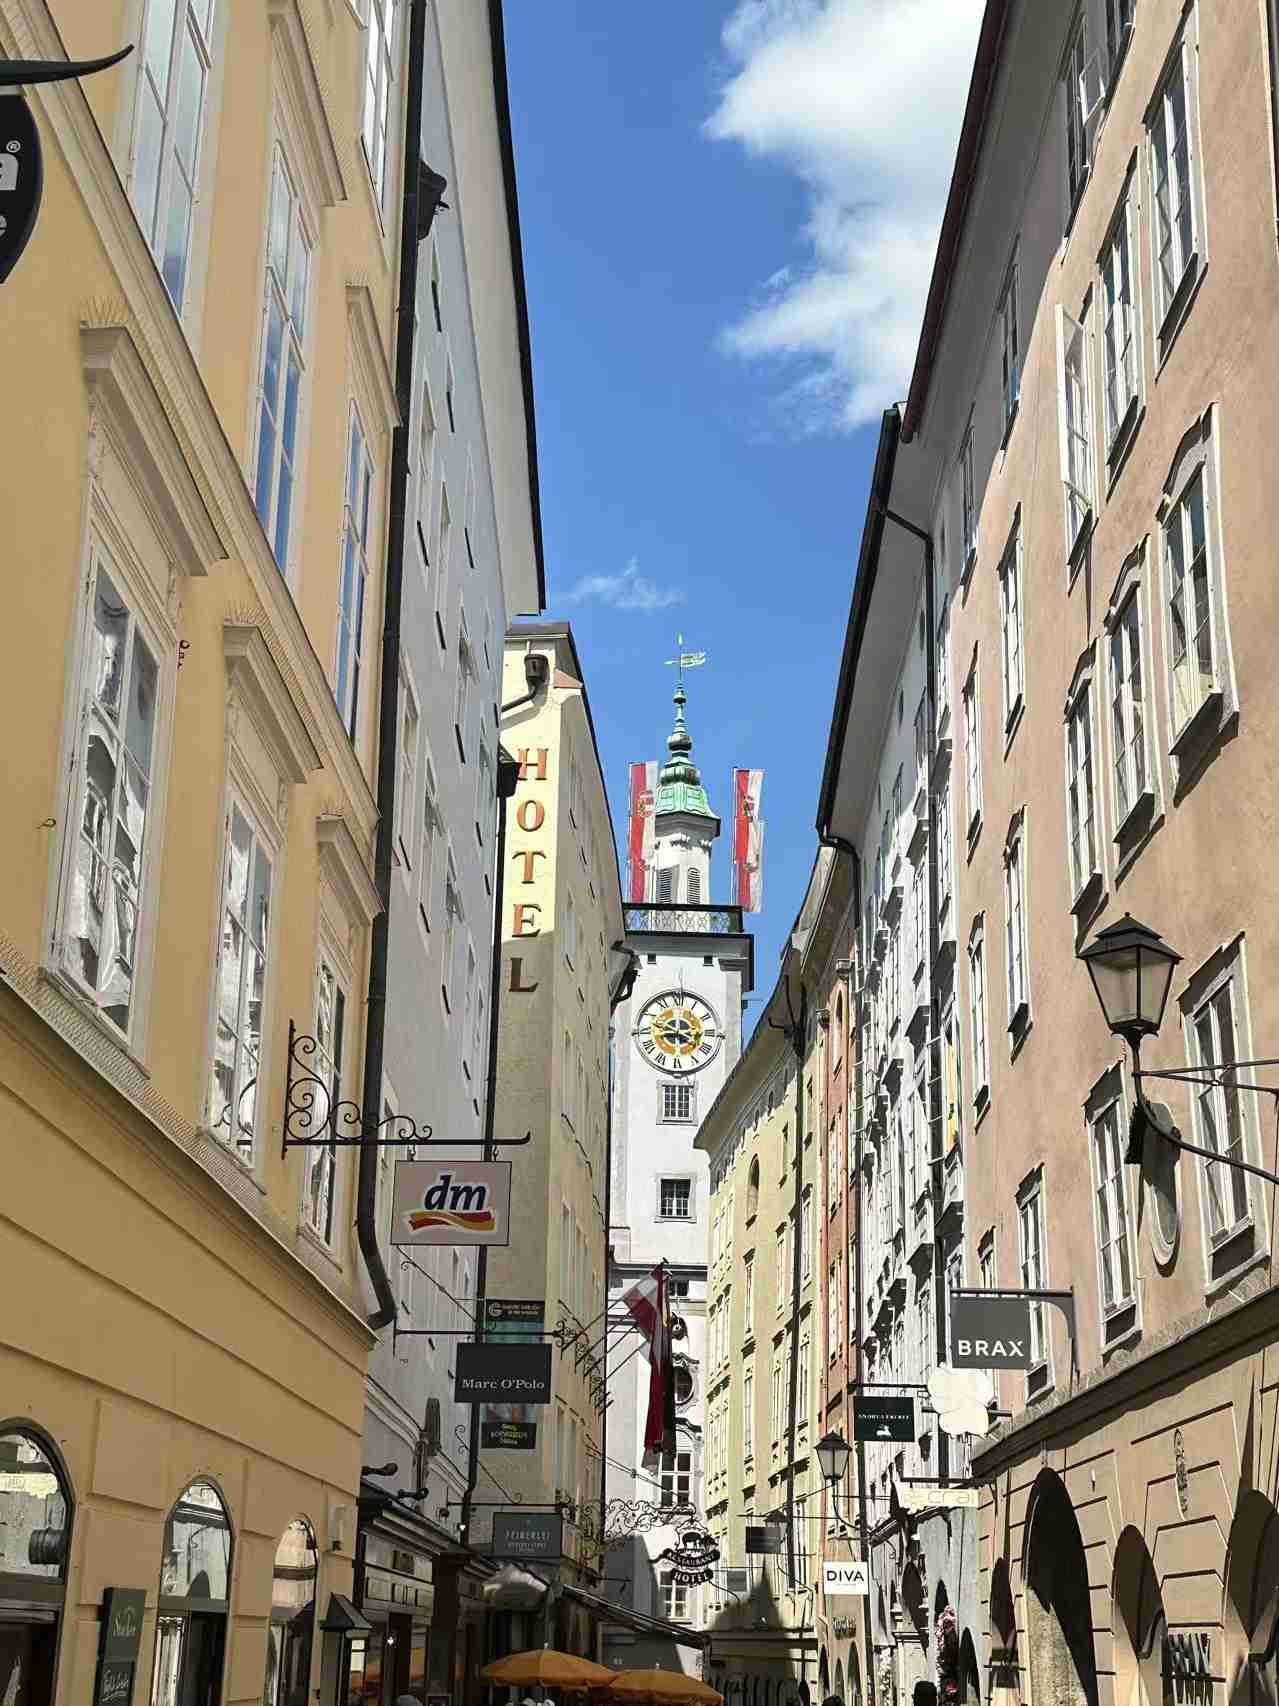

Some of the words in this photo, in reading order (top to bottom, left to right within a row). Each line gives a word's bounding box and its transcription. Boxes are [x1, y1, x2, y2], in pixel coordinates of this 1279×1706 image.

[509, 748, 549, 992] HOTEL
[424, 1175, 487, 1211] dm
[958, 1340, 1024, 1357] BRAX
[462, 1378, 498, 1390] Marc
[501, 1378, 545, 1390] O'Polo
[827, 1570, 864, 1582] DIVA
